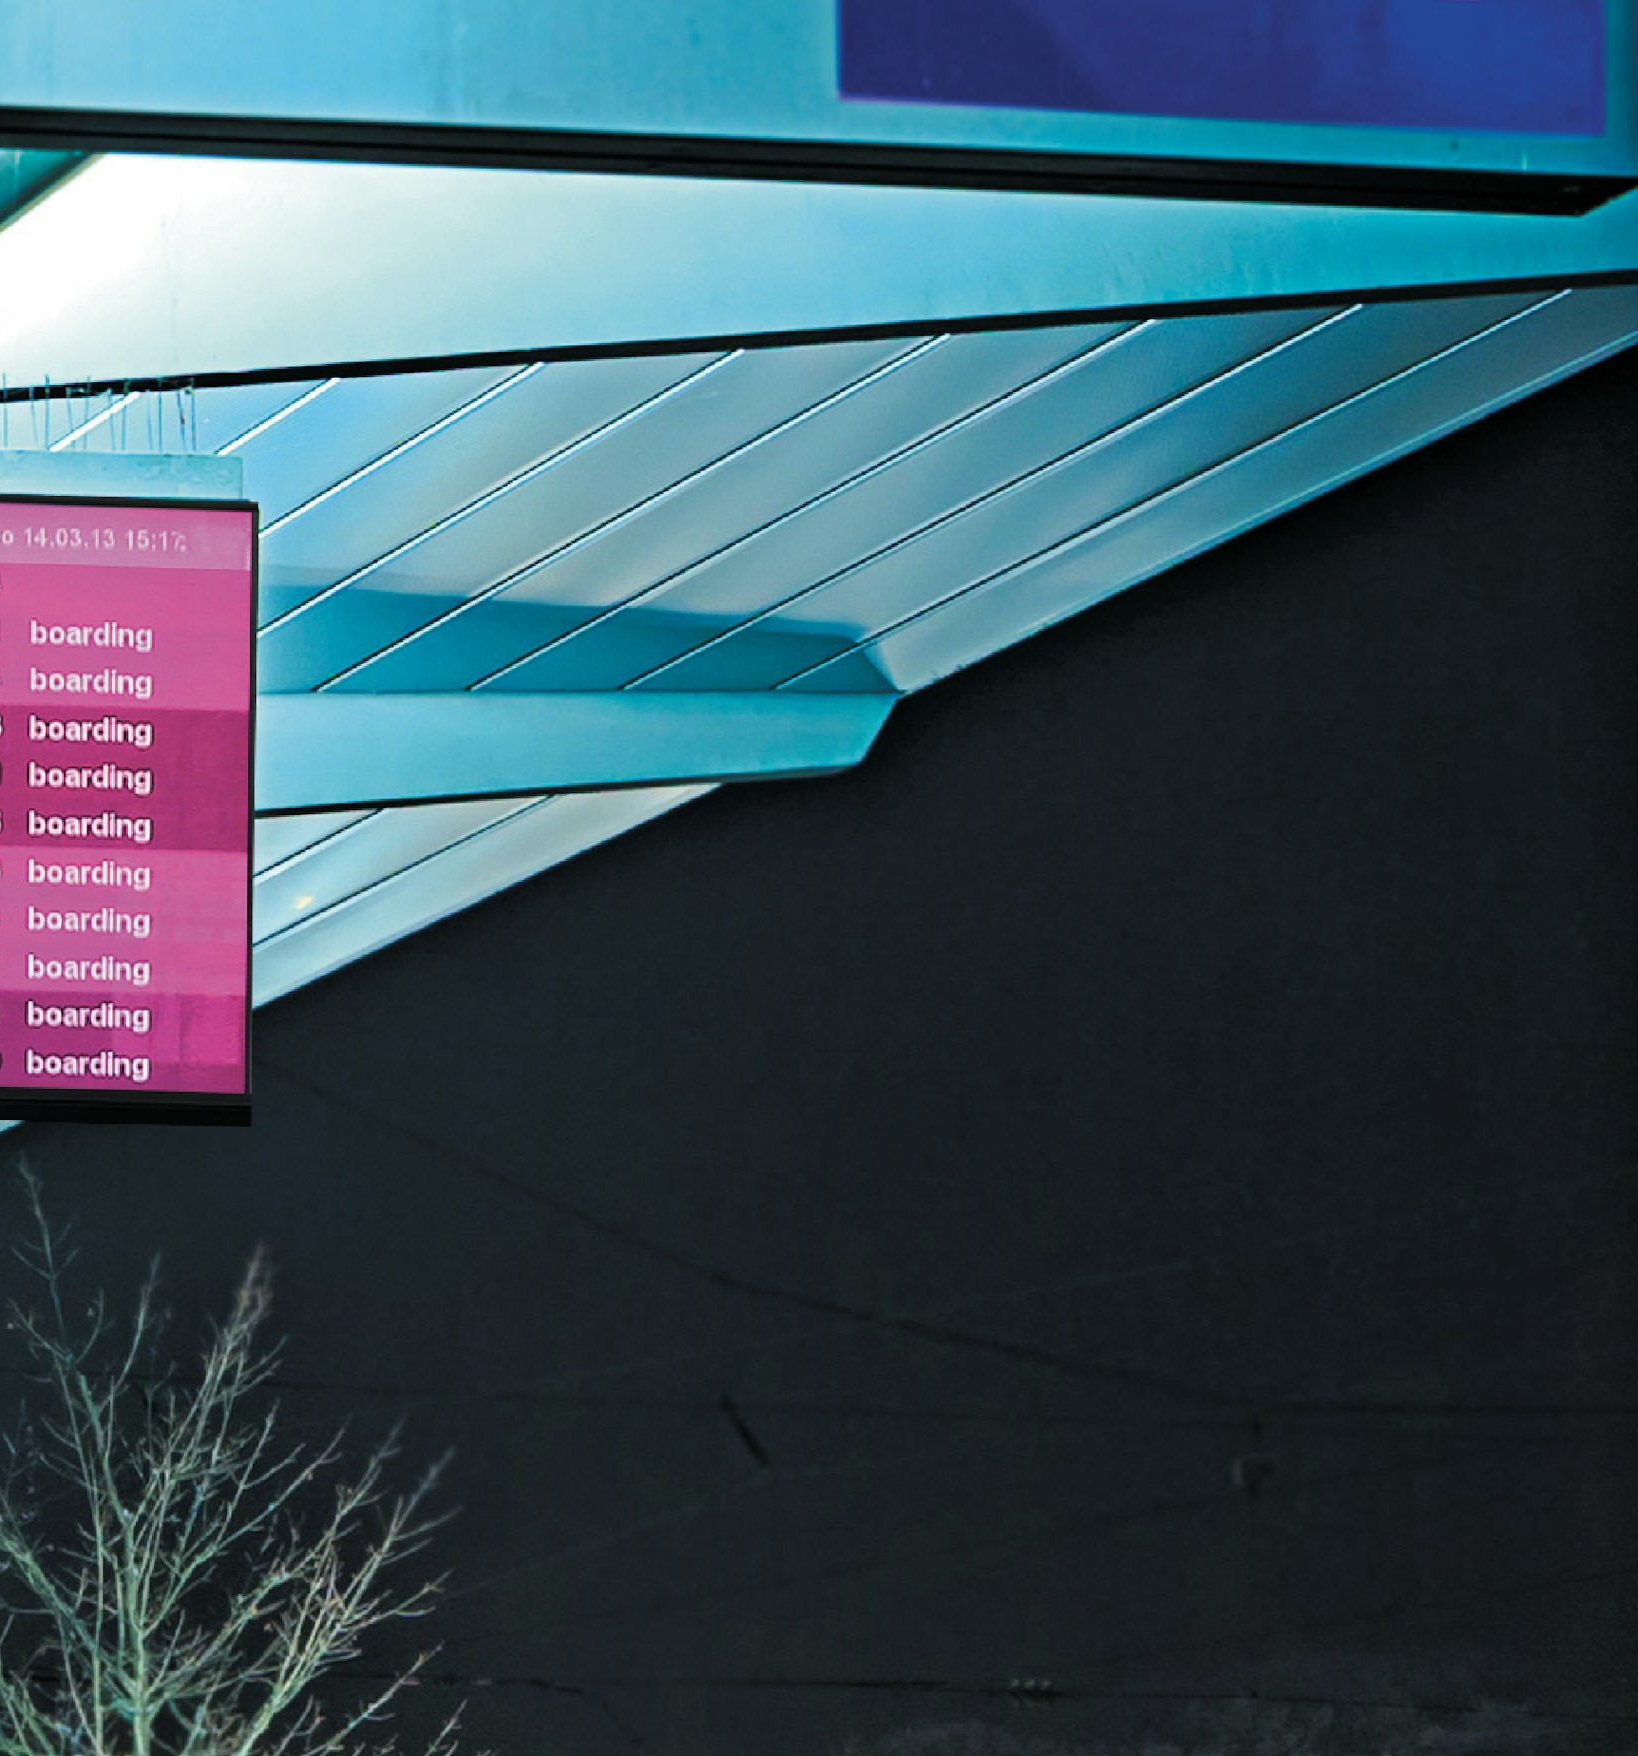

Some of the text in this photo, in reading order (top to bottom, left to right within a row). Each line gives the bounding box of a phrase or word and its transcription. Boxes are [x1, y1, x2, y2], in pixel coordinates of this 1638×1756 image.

[25, 527, 115, 549] 14.03.13
[30, 620, 153, 653] boarding
[30, 667, 153, 700] boarding
[28, 714, 153, 749] boarding
[28, 809, 151, 843] boarding
[28, 906, 151, 939] boarding
[27, 1000, 150, 1034] boarding
